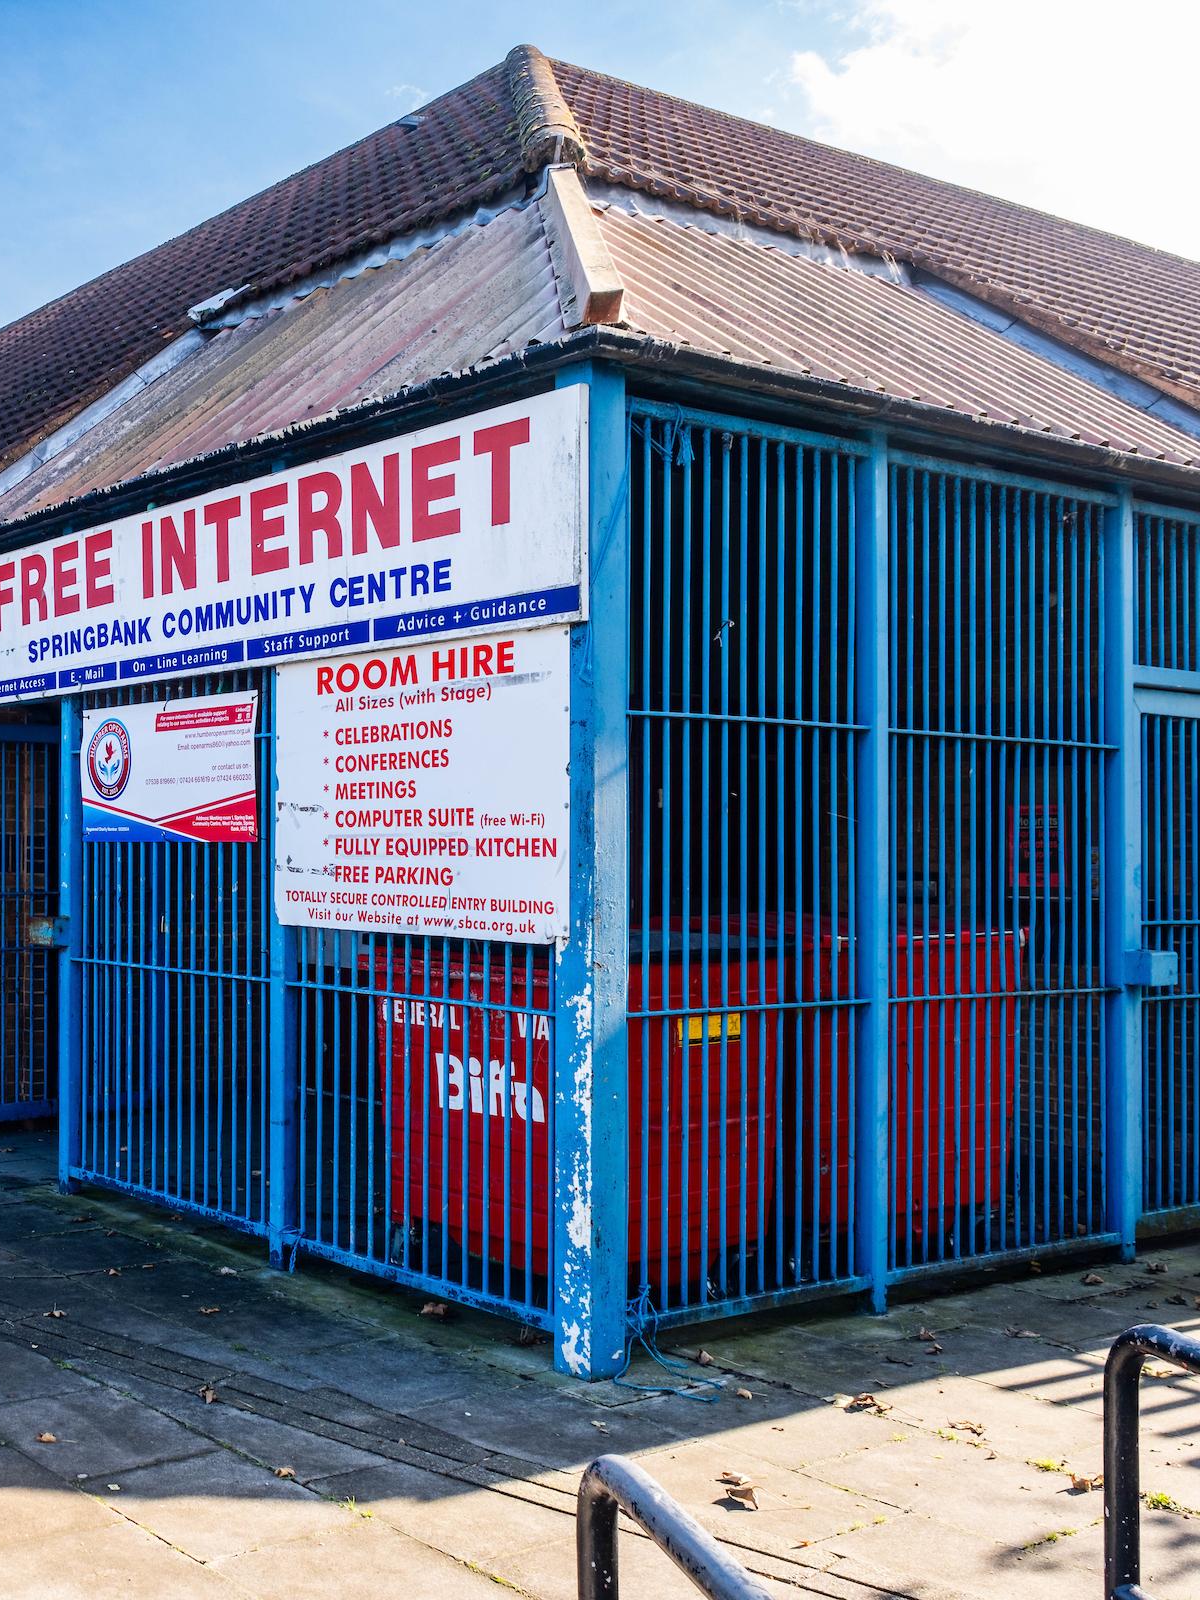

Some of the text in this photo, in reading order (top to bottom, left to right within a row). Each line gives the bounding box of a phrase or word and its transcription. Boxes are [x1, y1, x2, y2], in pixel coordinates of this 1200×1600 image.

[142, 418, 530, 598] INTERNET
[29, 559, 451, 663] SPRINGBANK COMMUNITY CENTRE
[397, 599, 546, 632] Advice + Guidance
[264, 629, 349, 652] Staff Support
[133, 662, 145, 672] On
[158, 658, 177, 668] Line
[182, 649, 227, 664] Learning
[317, 640, 515, 696] ROOM HIRE
[20, 678, 45, 690] Access
[336, 685, 491, 712] All Sizes (with Stage)
[90, 723, 129, 760] HUMBER OPEN ARMS
[336, 719, 452, 745] CELEBRATIONS
[336, 749, 448, 773] CONFERENCES
[336, 780, 416, 800] MEETINGS
[335, 807, 544, 828] COMPUTER SUITE (free Wi-Fi)
[336, 837, 557, 858] FULLY EQUIPPED KITCHEN
[335, 865, 454, 886] FREE PARKING
[286, 890, 554, 915] TOTALLY SECURE CONTROLLED ENTRY BUILDING
[308, 908, 536, 935] Visit our Website at www.sbca.org.uk
